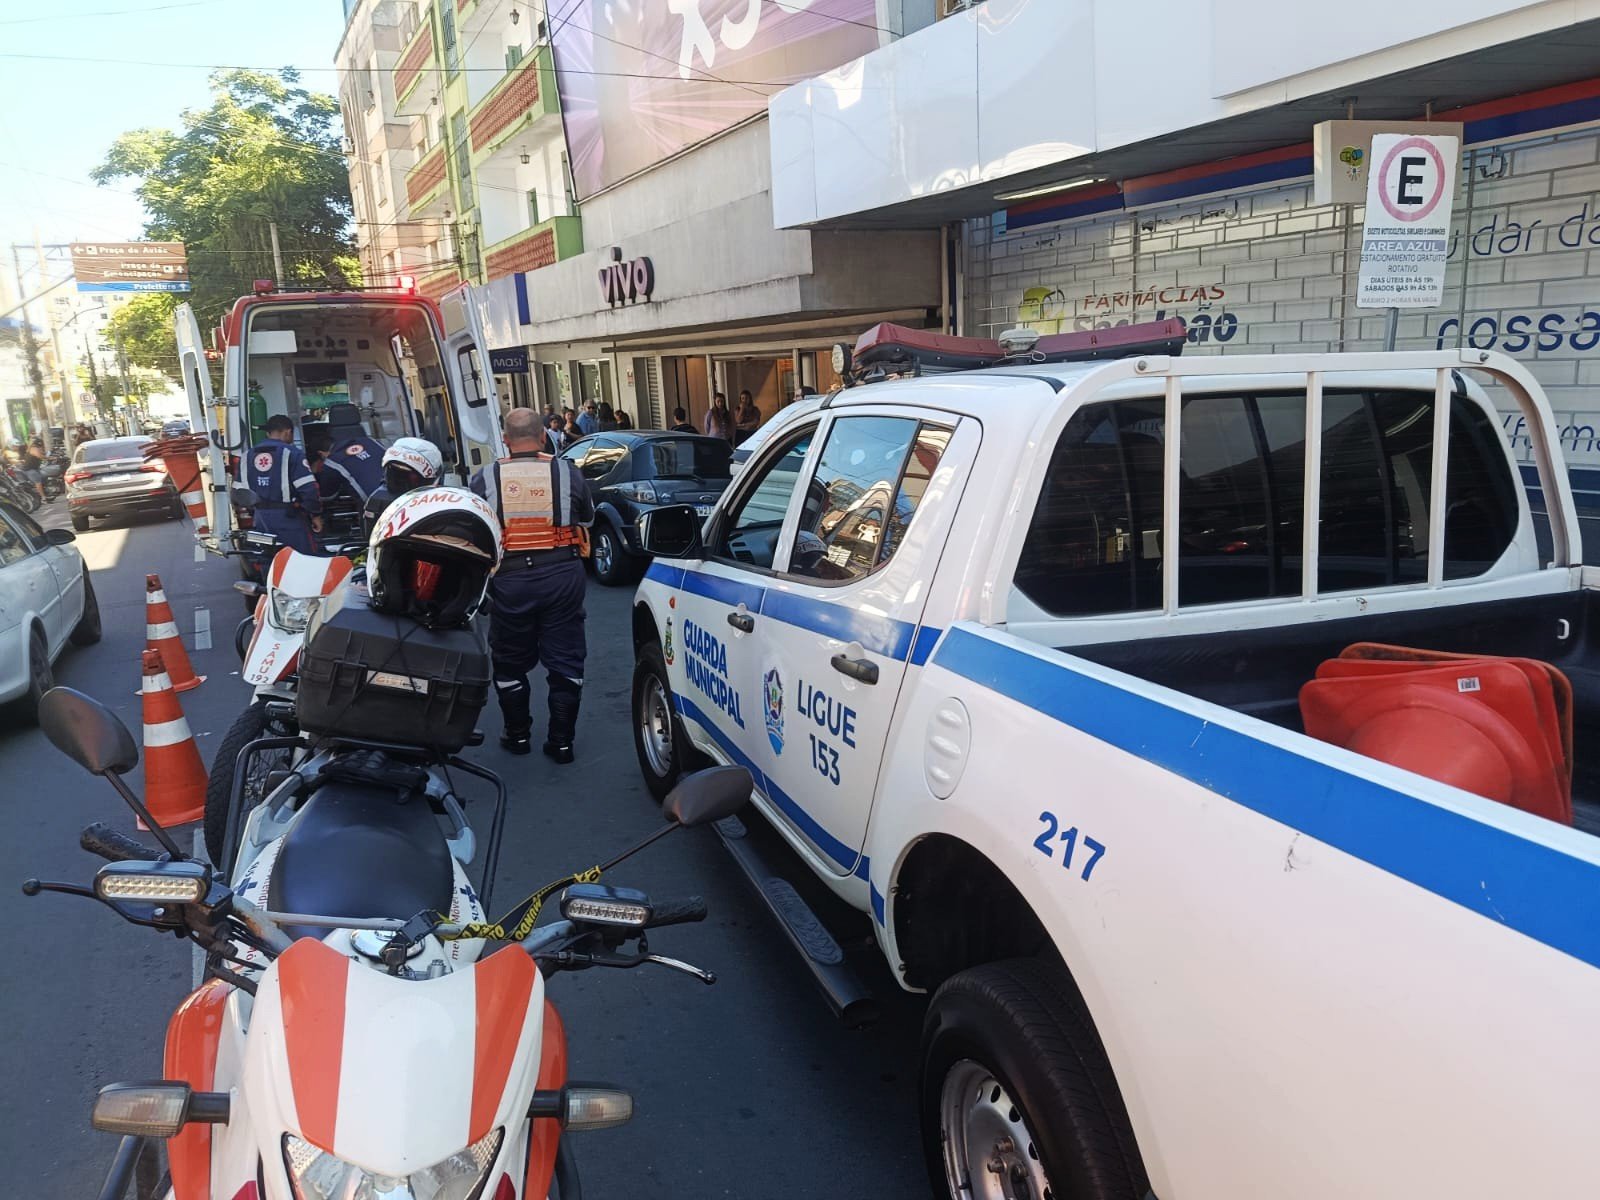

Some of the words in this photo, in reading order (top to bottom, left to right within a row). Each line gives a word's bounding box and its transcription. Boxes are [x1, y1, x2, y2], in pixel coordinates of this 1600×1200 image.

[1397, 157, 1427, 205] E
[1361, 254, 1416, 262] ESTACIONAMENTO
[1417, 254, 1446, 262] GRATUITO
[1406, 241, 1439, 251] AZUL
[1386, 275, 1404, 283] ÚTEIS
[1388, 264, 1418, 273] ROTATIVO
[1083, 284, 1225, 311] FARMÁCIAS
[1155, 302, 1238, 342] ão
[408, 493, 463, 508] SAMU
[529, 489, 545, 497] 192
[259, 643, 281, 674] SAMU
[683, 618, 728, 679] GUARDA
[250, 674, 269, 683] 192
[684, 651, 746, 731] MUNICIPAL
[797, 679, 857, 749] LIGUE
[809, 733, 841, 786] 153
[1033, 810, 1106, 882] 217
[471, 904, 480, 922] SUS
[515, 893, 542, 941] MUNDO
